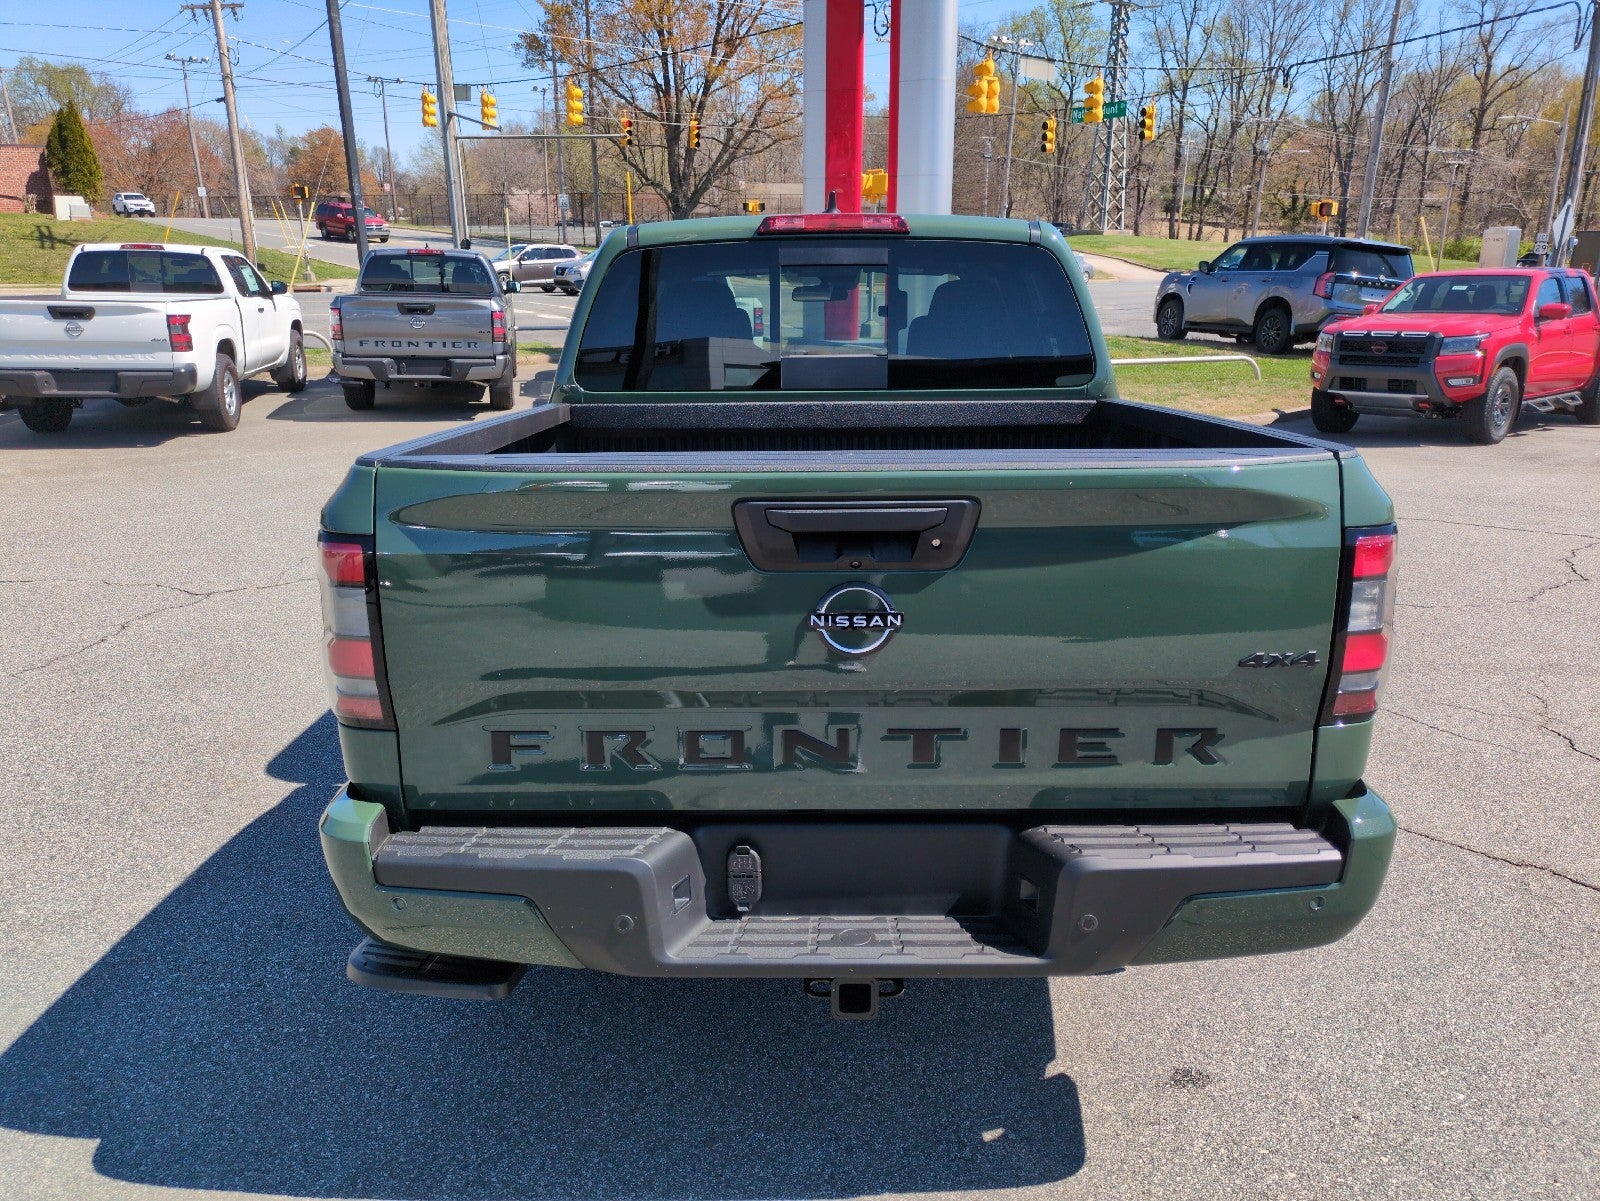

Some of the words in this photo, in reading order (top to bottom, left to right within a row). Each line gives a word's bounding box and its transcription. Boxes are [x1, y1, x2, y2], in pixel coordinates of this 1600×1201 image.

[1535, 244, 1547, 253] 29
[359, 340, 479, 349] FRONTIER
[810, 614, 902, 627] NISSAN
[487, 727, 1227, 771] FRONTIER
